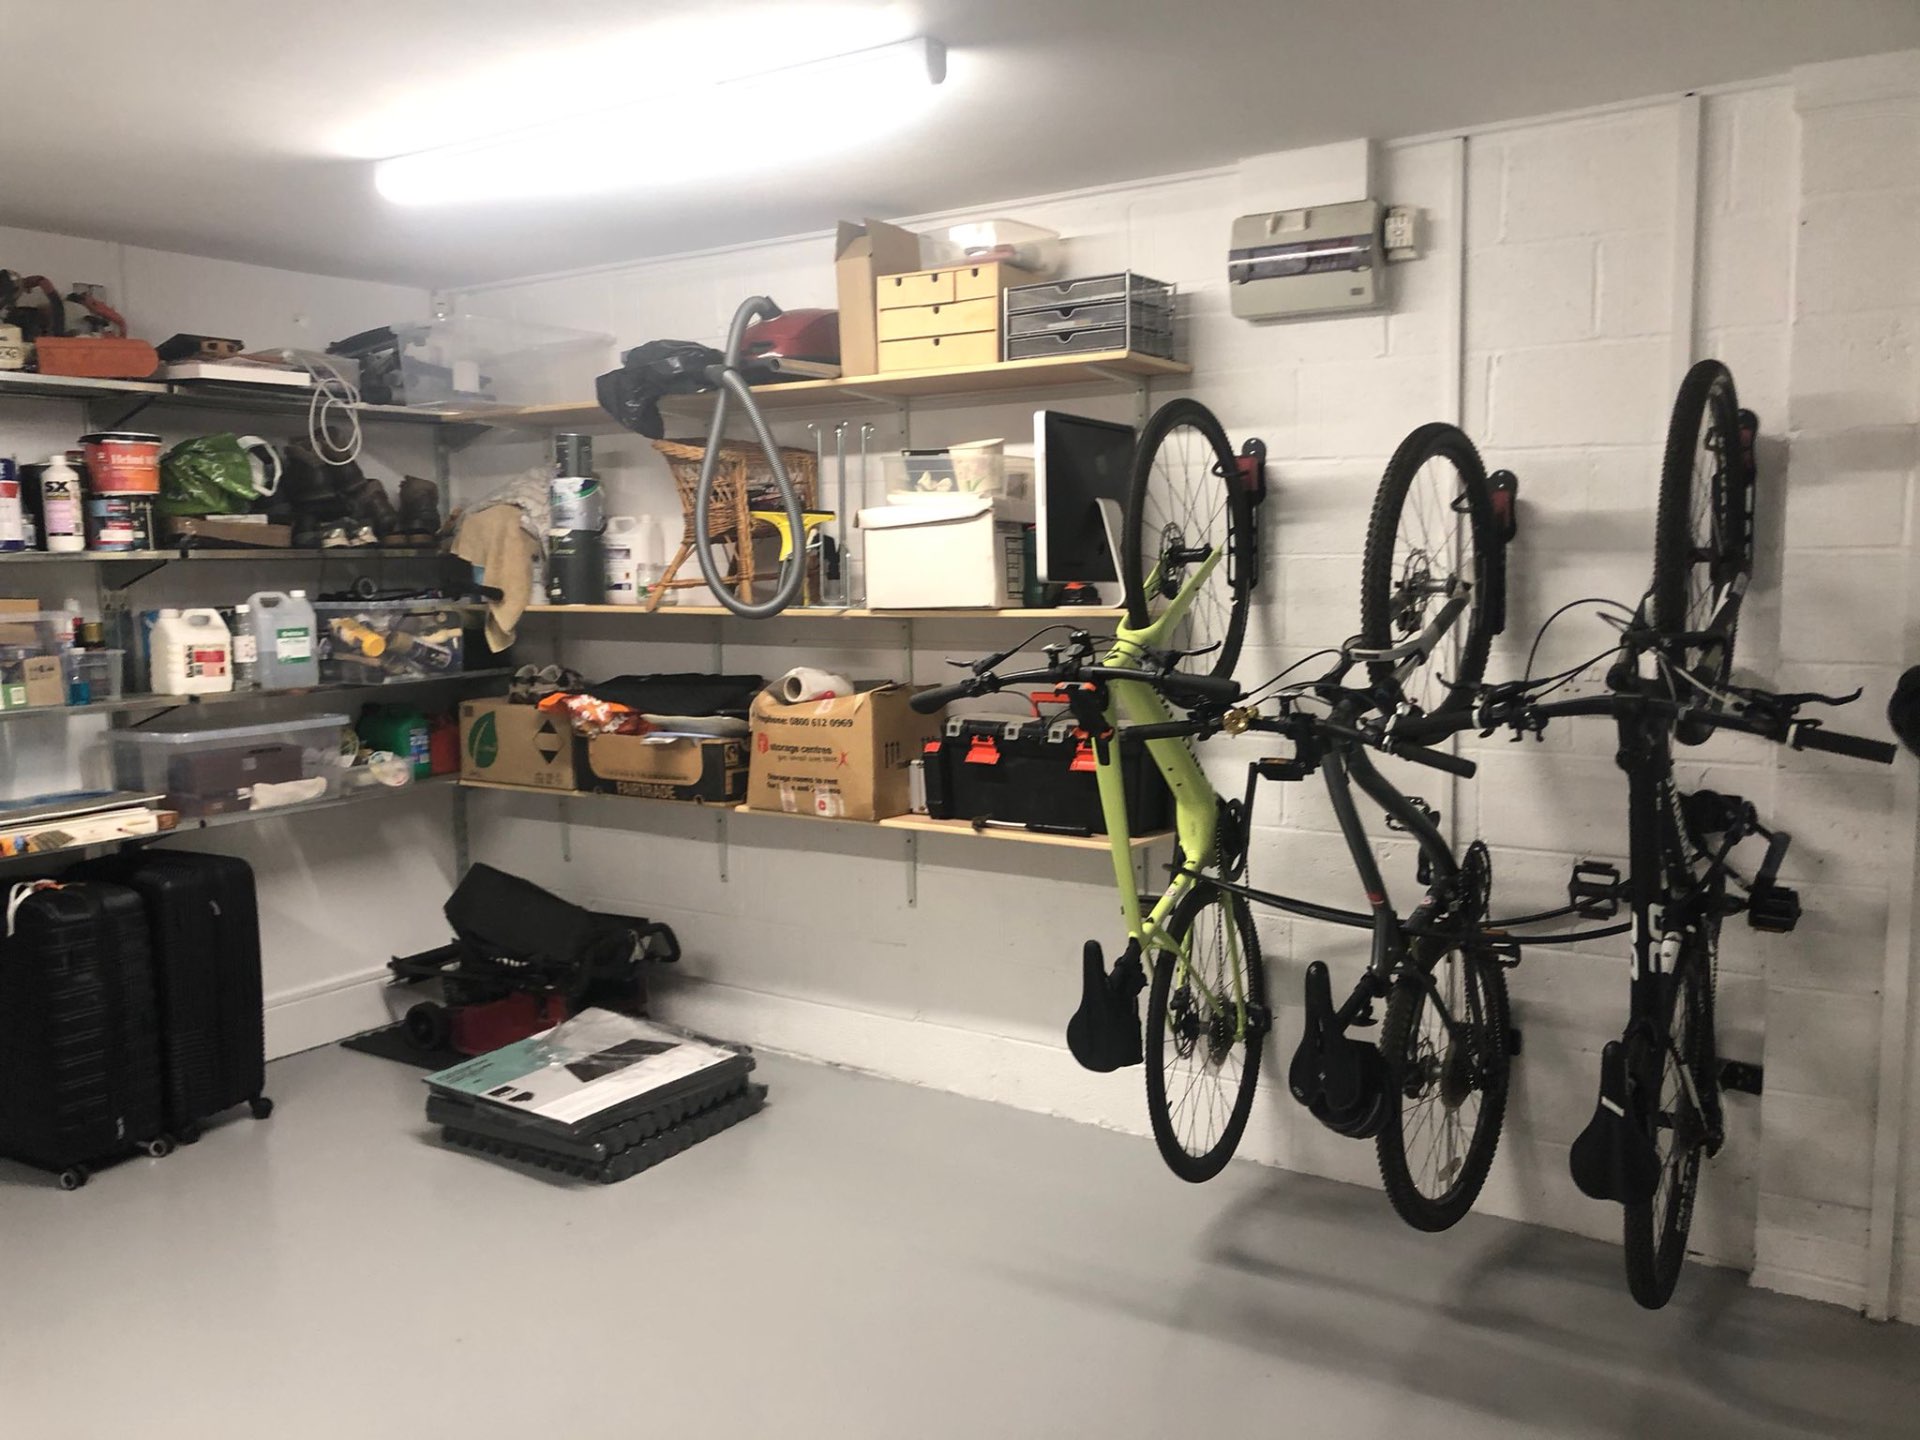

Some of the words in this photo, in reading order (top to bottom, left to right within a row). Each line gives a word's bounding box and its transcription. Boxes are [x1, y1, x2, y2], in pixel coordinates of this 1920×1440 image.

[45, 481, 69, 493] SX
[790, 717, 809, 727] 0800
[811, 718, 827, 727] 612
[830, 718, 853, 728] 0969
[770, 743, 799, 754] storage
[801, 745, 832, 754] centres
